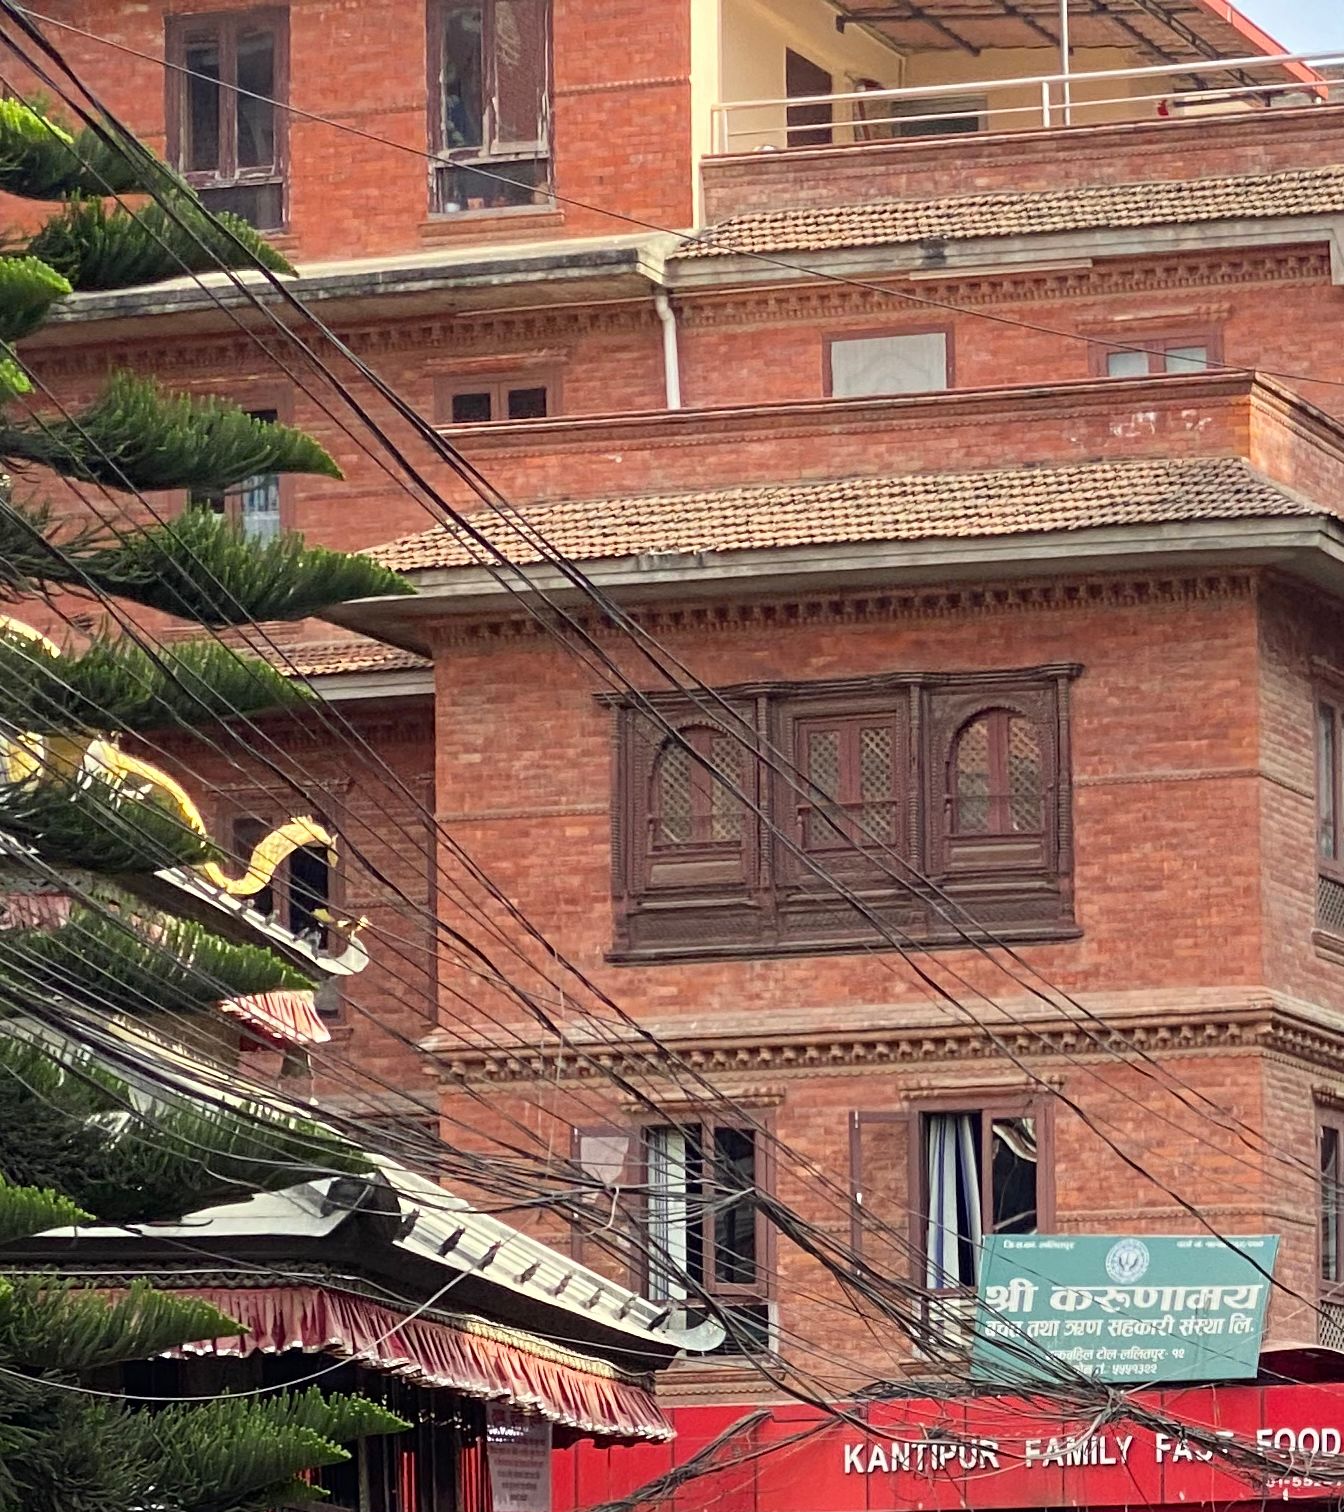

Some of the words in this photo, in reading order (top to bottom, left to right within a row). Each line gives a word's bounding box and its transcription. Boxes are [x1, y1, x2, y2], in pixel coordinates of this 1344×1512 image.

[985, 1278, 1040, 1314] श्री
[1026, 1320, 1061, 1338] तथा
[1107, 1314, 1175, 1338] सहकारी
[1179, 1314, 1227, 1338] संस्था
[1227, 1315, 1255, 1336] लि.
[843, 1439, 1001, 1475] KANTIPUR
[1024, 1435, 1134, 1468] FAMILY
